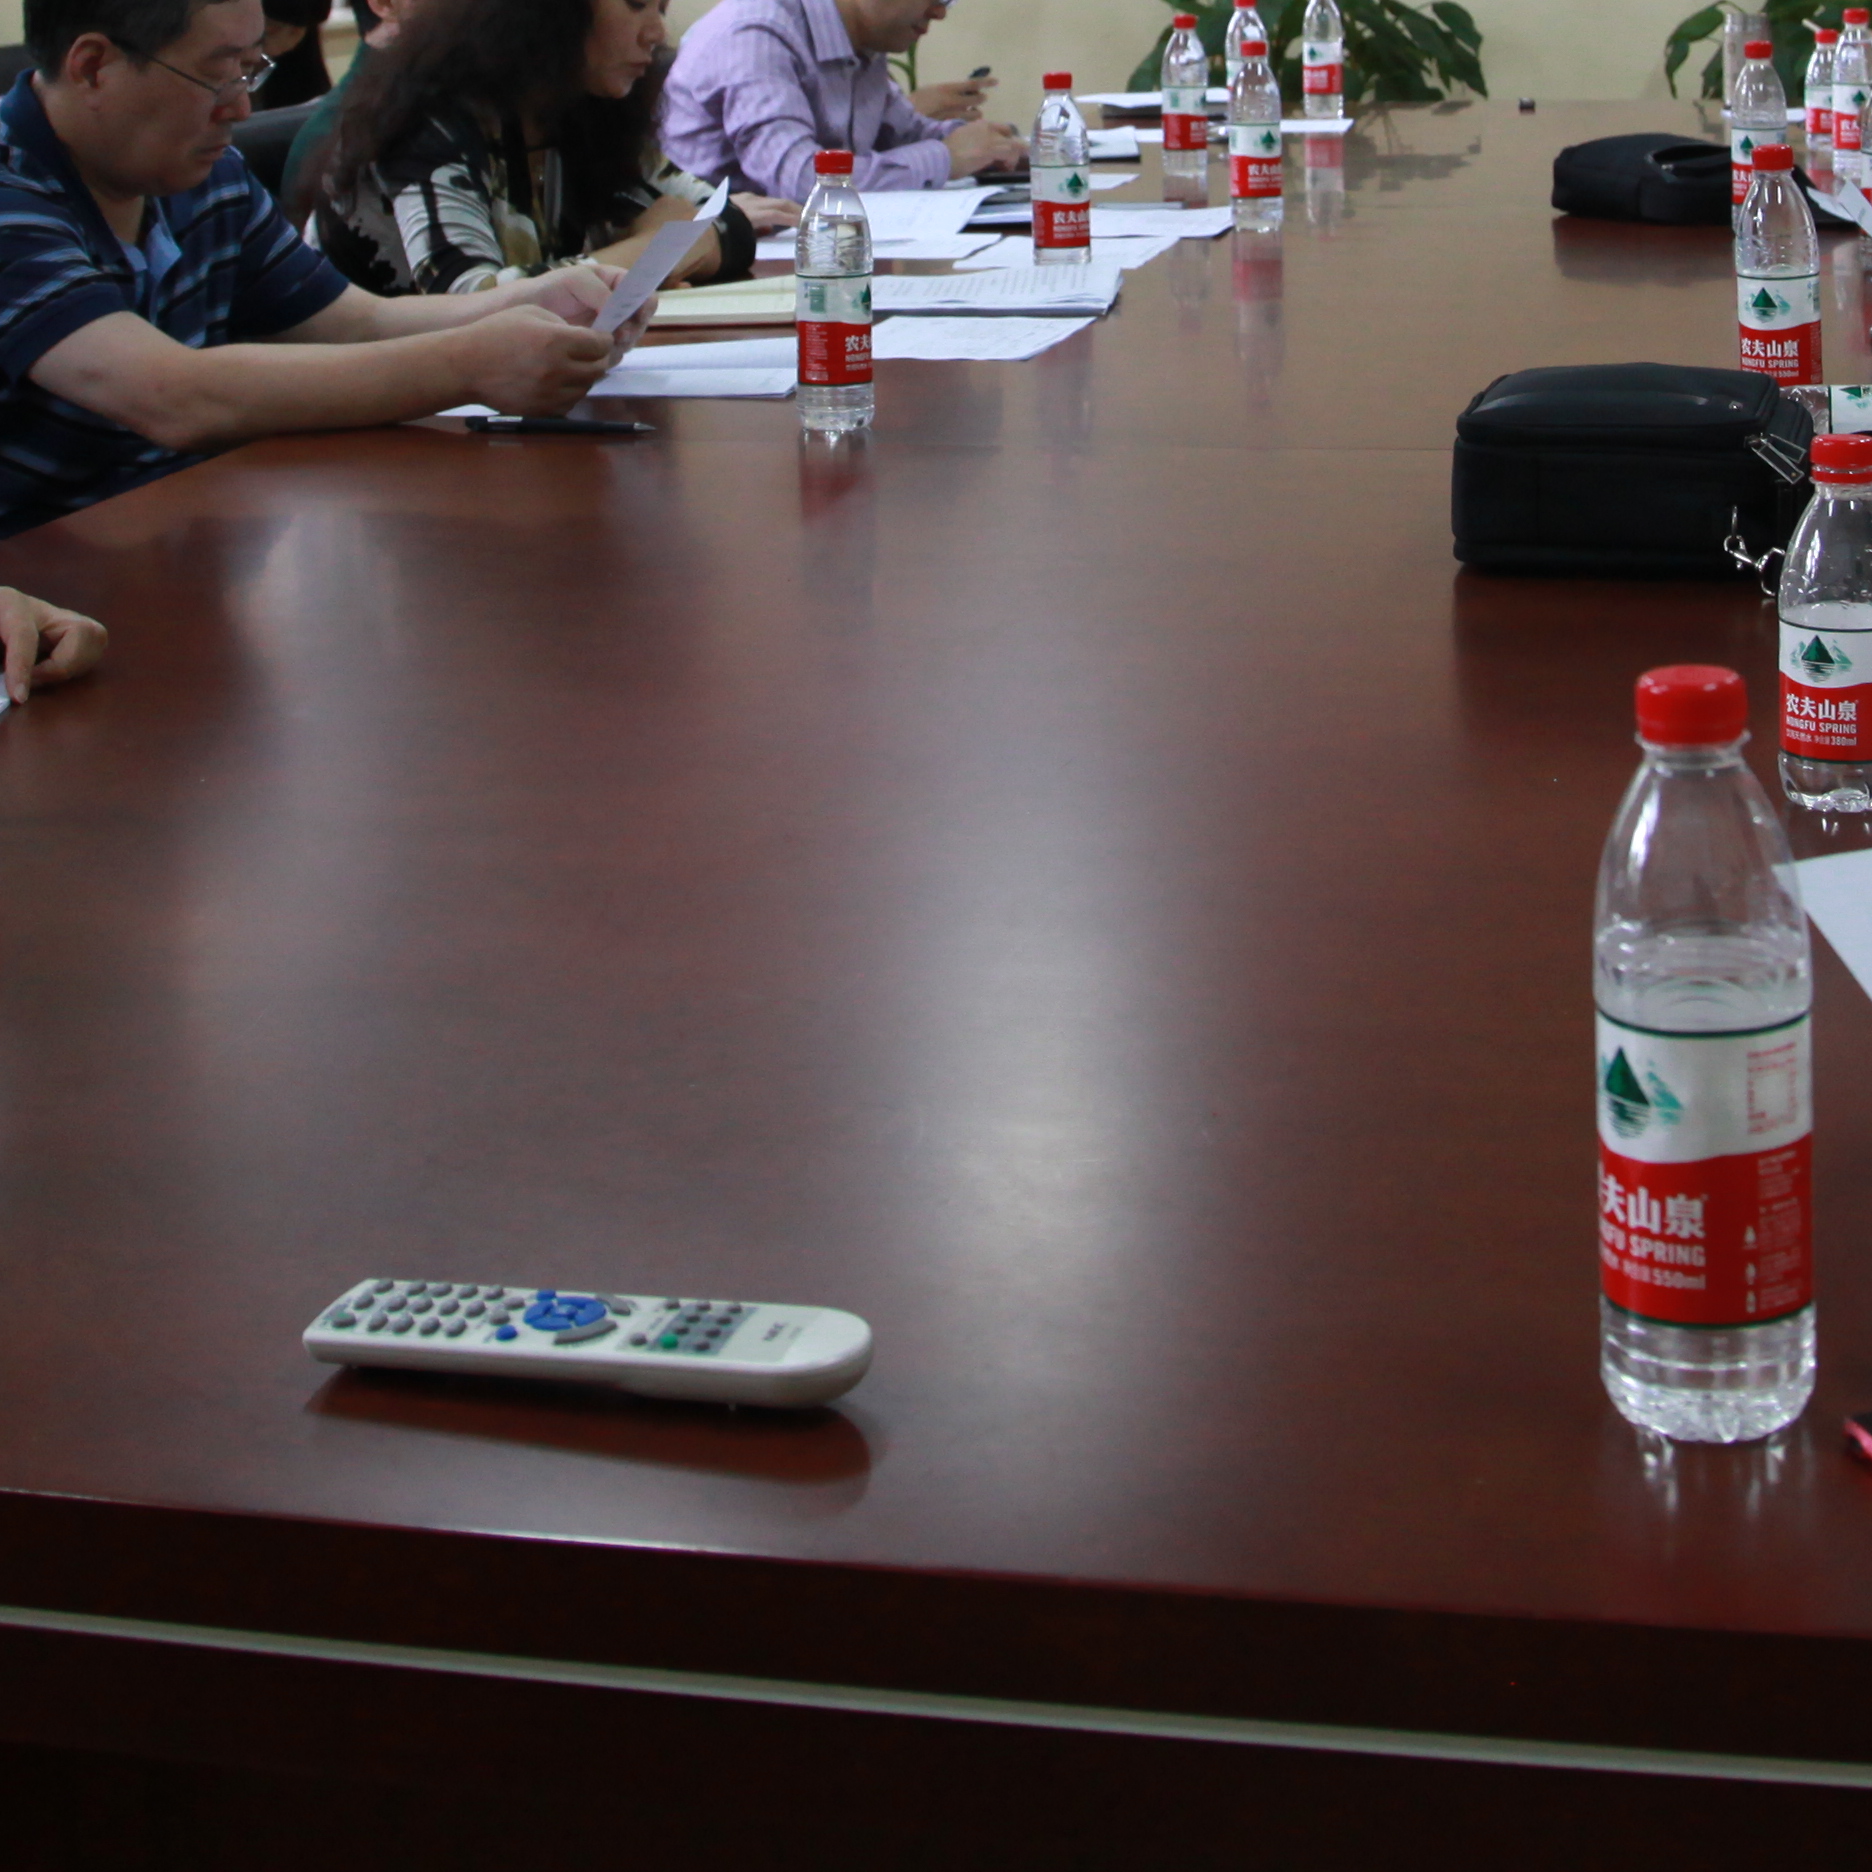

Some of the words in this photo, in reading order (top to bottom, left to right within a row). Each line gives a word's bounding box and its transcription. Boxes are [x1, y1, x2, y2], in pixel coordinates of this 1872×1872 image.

[1741, 337, 1799, 358] 农夫山泉
[1768, 359, 1799, 369] SPRING
[1786, 693, 1857, 721] 农夫山泉
[1819, 722, 1857, 734] SPRING
[1598, 1162, 1705, 1239] 夫山泉
[1629, 1233, 1706, 1268] SPRING
